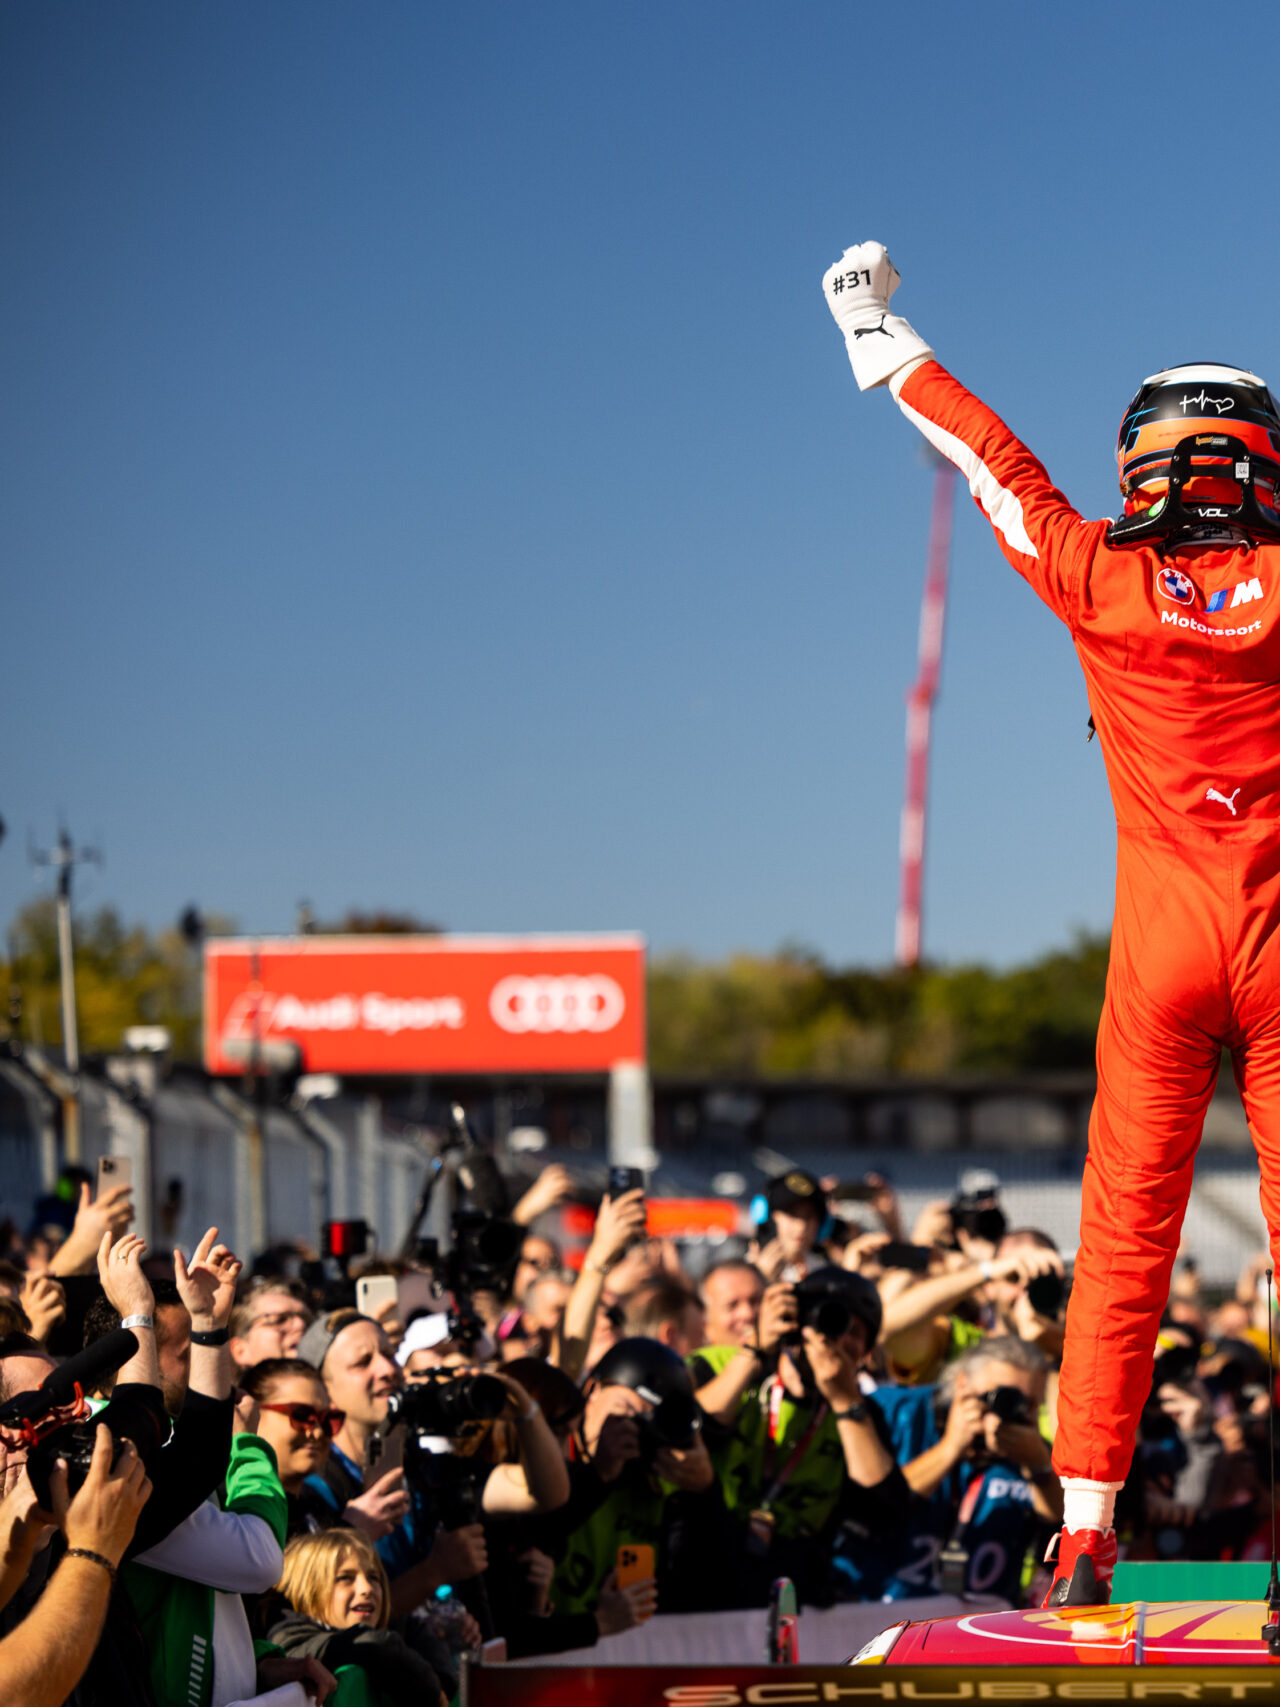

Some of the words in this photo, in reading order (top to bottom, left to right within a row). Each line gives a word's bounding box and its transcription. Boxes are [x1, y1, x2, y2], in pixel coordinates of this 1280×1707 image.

[832, 269, 872, 296] #31
[1230, 577, 1264, 608] M
[1161, 610, 1262, 636] Motorsport
[361, 991, 464, 1034] Sport
[663, 1682, 1274, 1707] SCHUBERT
